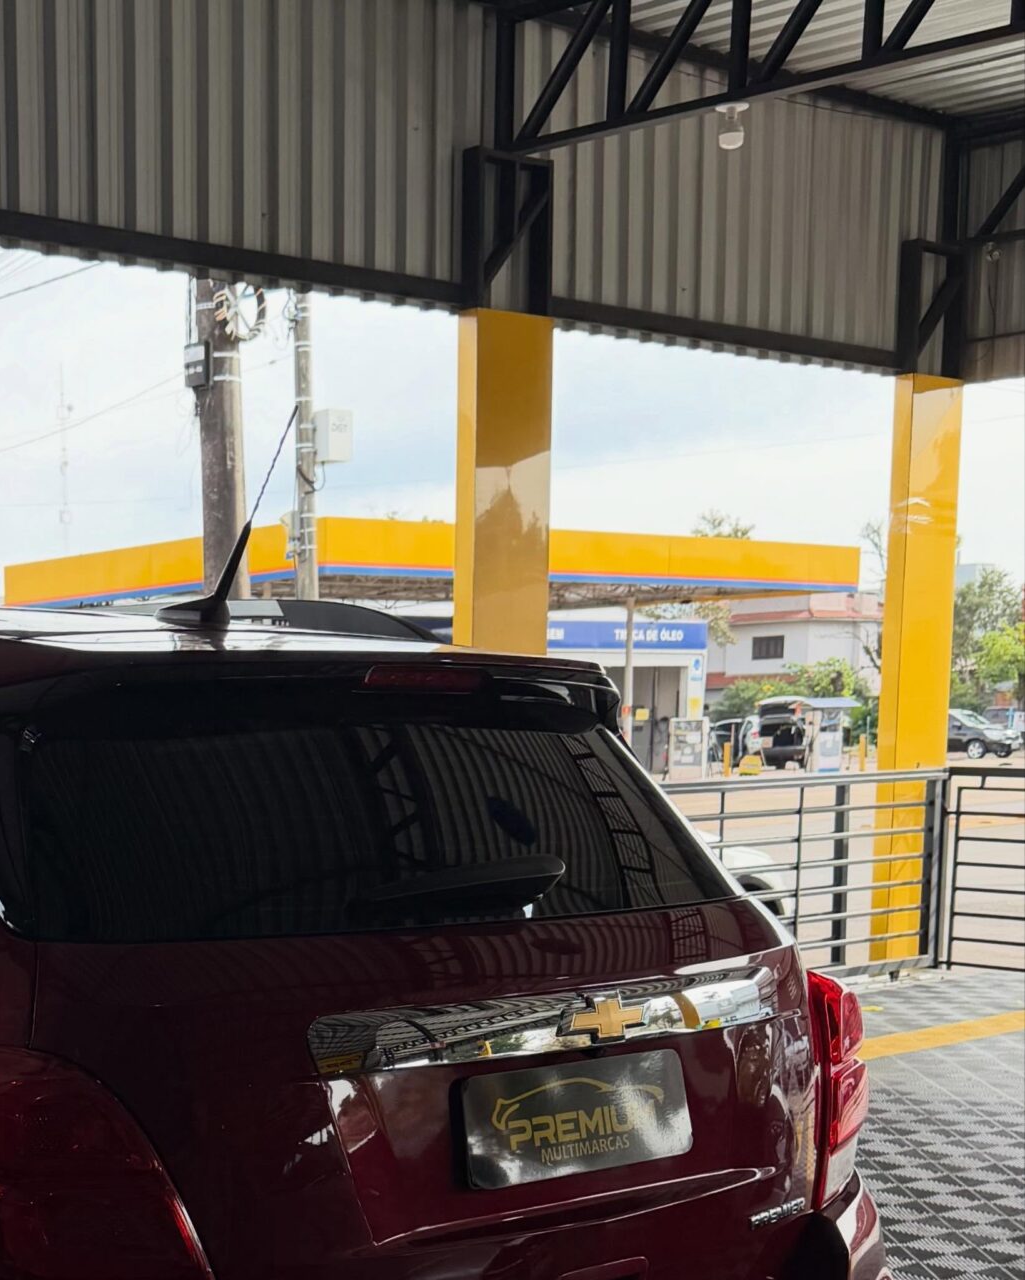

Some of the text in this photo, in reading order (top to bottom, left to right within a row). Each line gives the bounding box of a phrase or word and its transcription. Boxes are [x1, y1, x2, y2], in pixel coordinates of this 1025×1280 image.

[613, 626, 684, 641] TRCA DE ÓLEO
[541, 1134, 630, 1166] MULTIMARCAS
[749, 1197, 806, 1230] PREMIER
